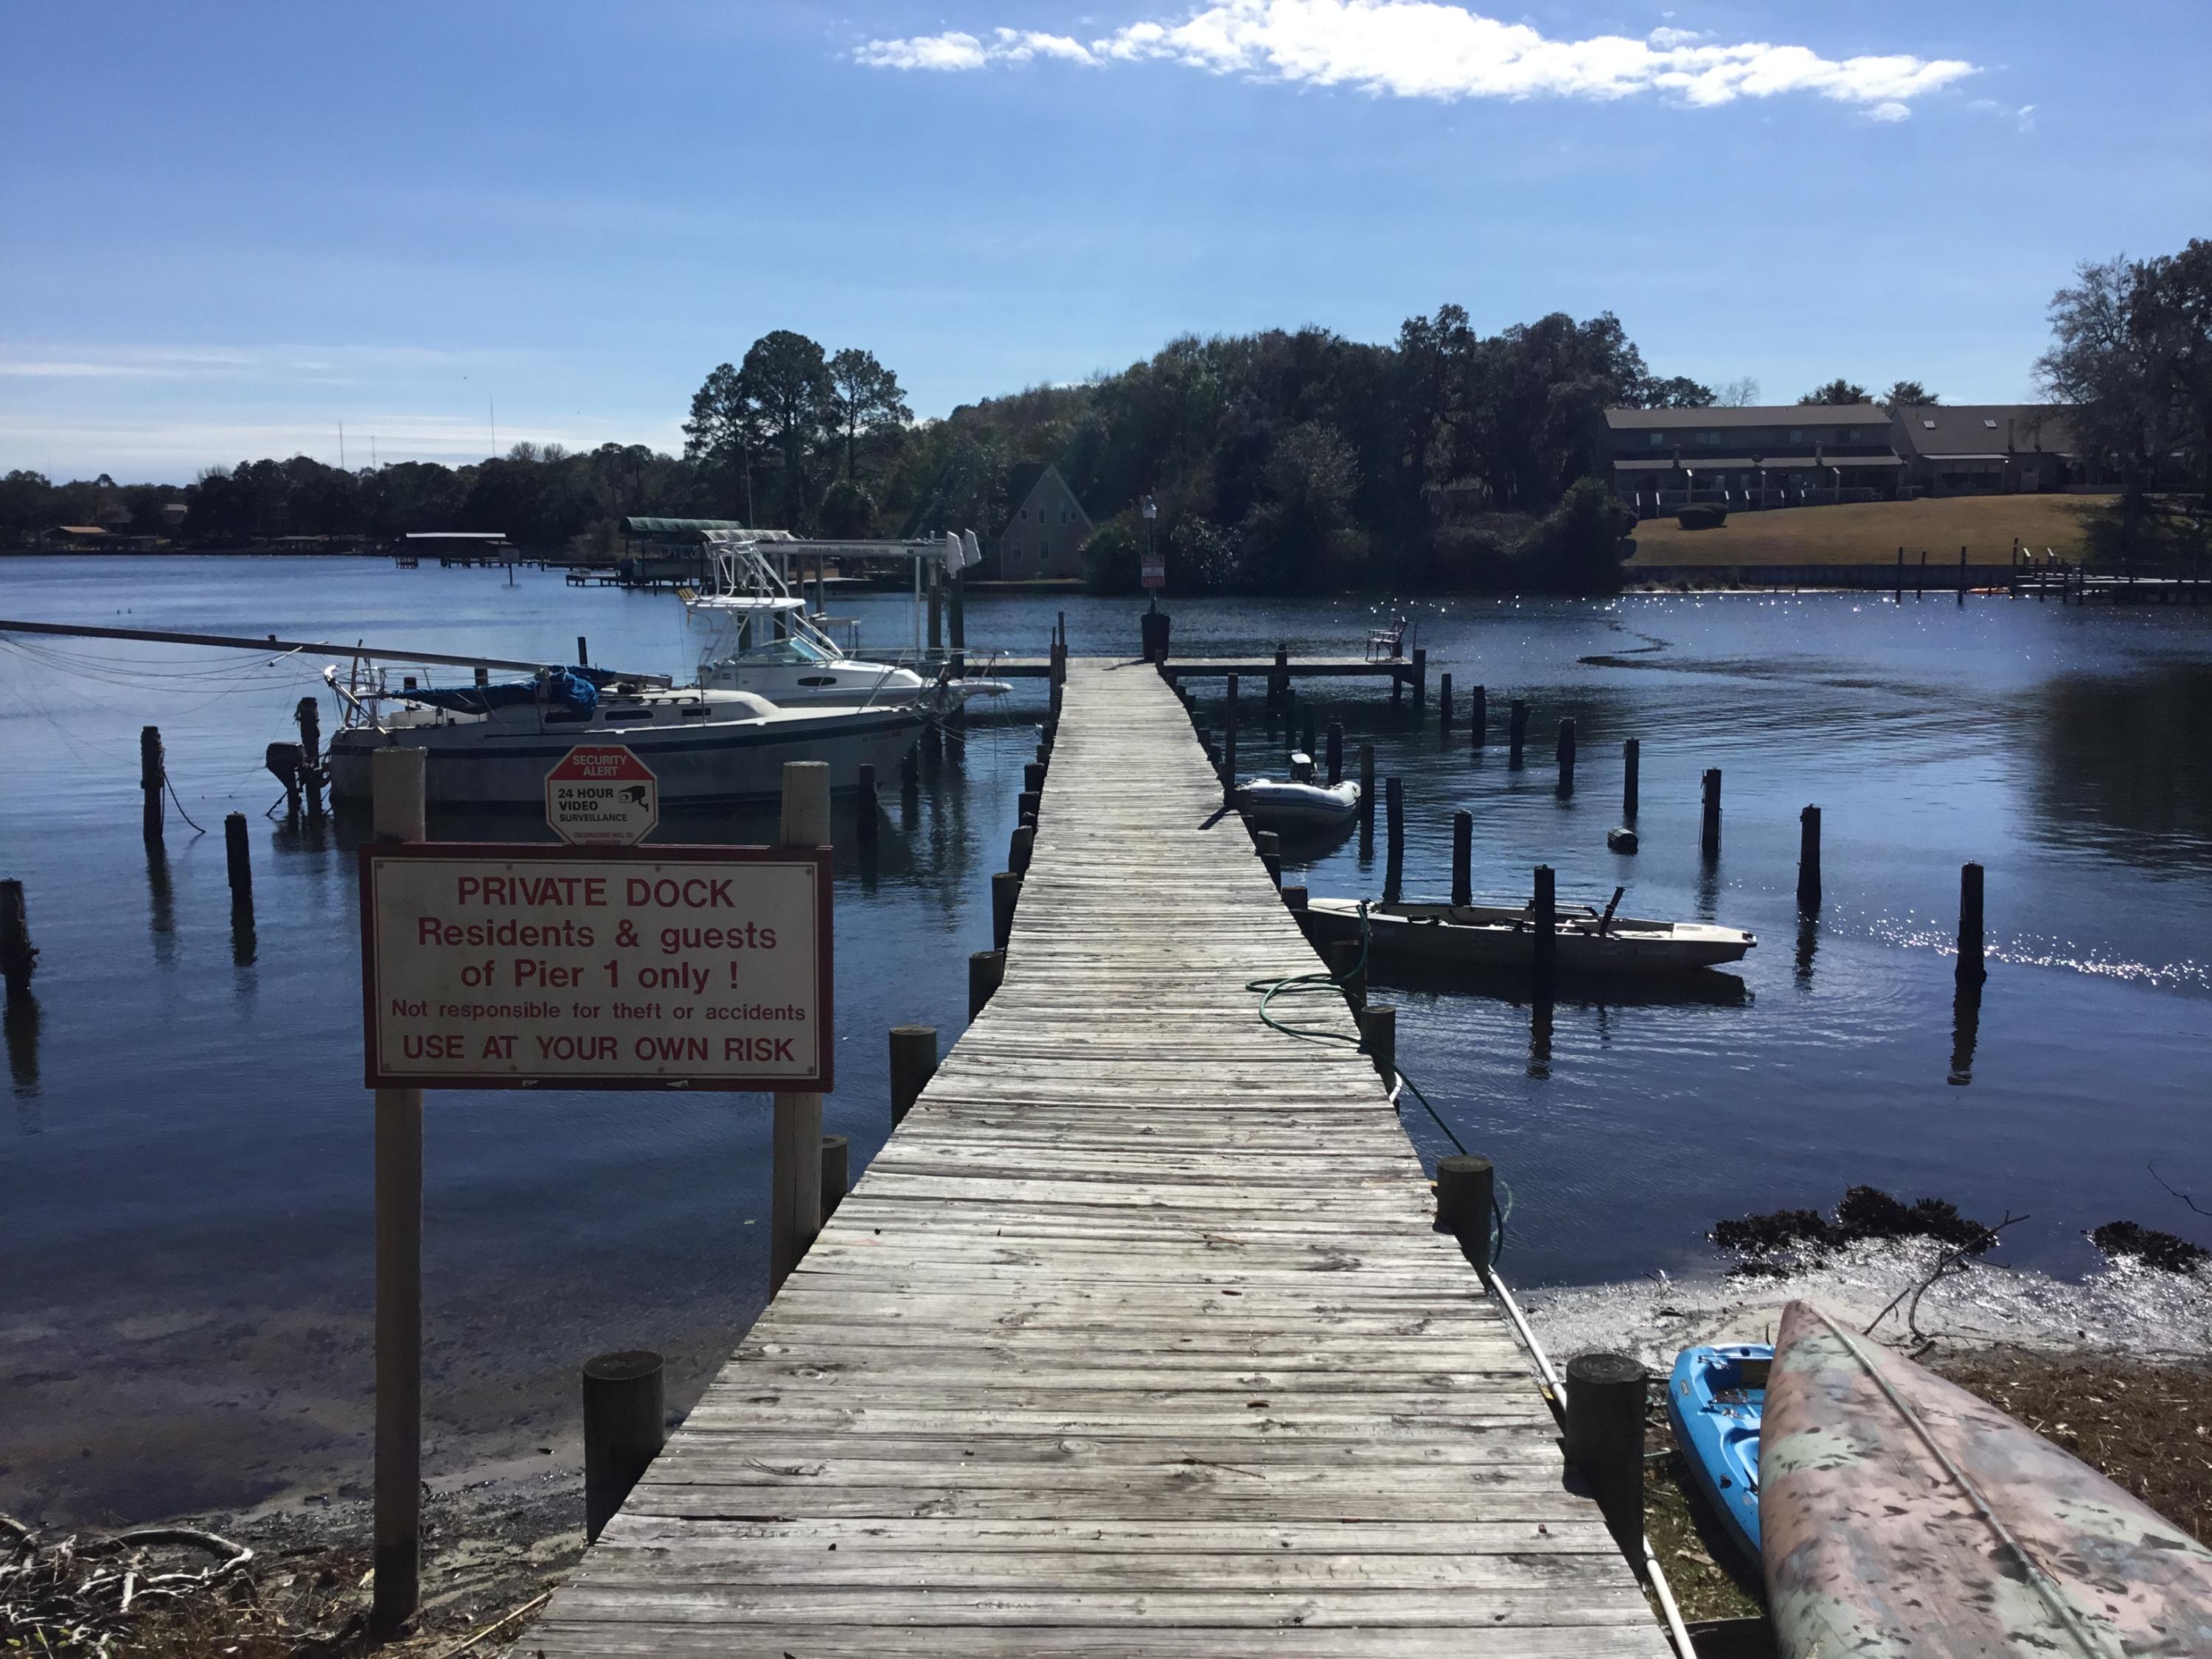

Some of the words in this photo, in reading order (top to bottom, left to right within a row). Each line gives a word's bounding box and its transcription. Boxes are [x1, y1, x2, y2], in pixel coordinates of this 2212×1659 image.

[573, 755, 627, 765] SECURITY
[584, 766, 618, 776] ALERT
[558, 788, 574, 798] 24
[577, 788, 613, 798] HOUR
[559, 801, 598, 810] VIDEO
[457, 876, 608, 906] PRIVATE
[626, 878, 736, 908] DOCK
[418, 917, 595, 947] Residents
[615, 919, 640, 948] &
[660, 921, 777, 955] guests
[460, 959, 495, 987] of
[515, 959, 585, 988] Pier
[603, 959, 619, 988] 1
[638, 961, 710, 995] only
[730, 961, 738, 990] !
[392, 999, 428, 1018] Not
[439, 1001, 561, 1021] responsible
[571, 1002, 601, 1018] for
[612, 1002, 662, 1020] theft
[672, 1006, 695, 1020] or
[705, 1004, 806, 1021] accidents
[403, 1034, 465, 1060] USE
[481, 1035, 519, 1060] AT
[535, 1035, 618, 1061] YOUR
[635, 1037, 709, 1062] OWN
[724, 1037, 796, 1062] RISK
